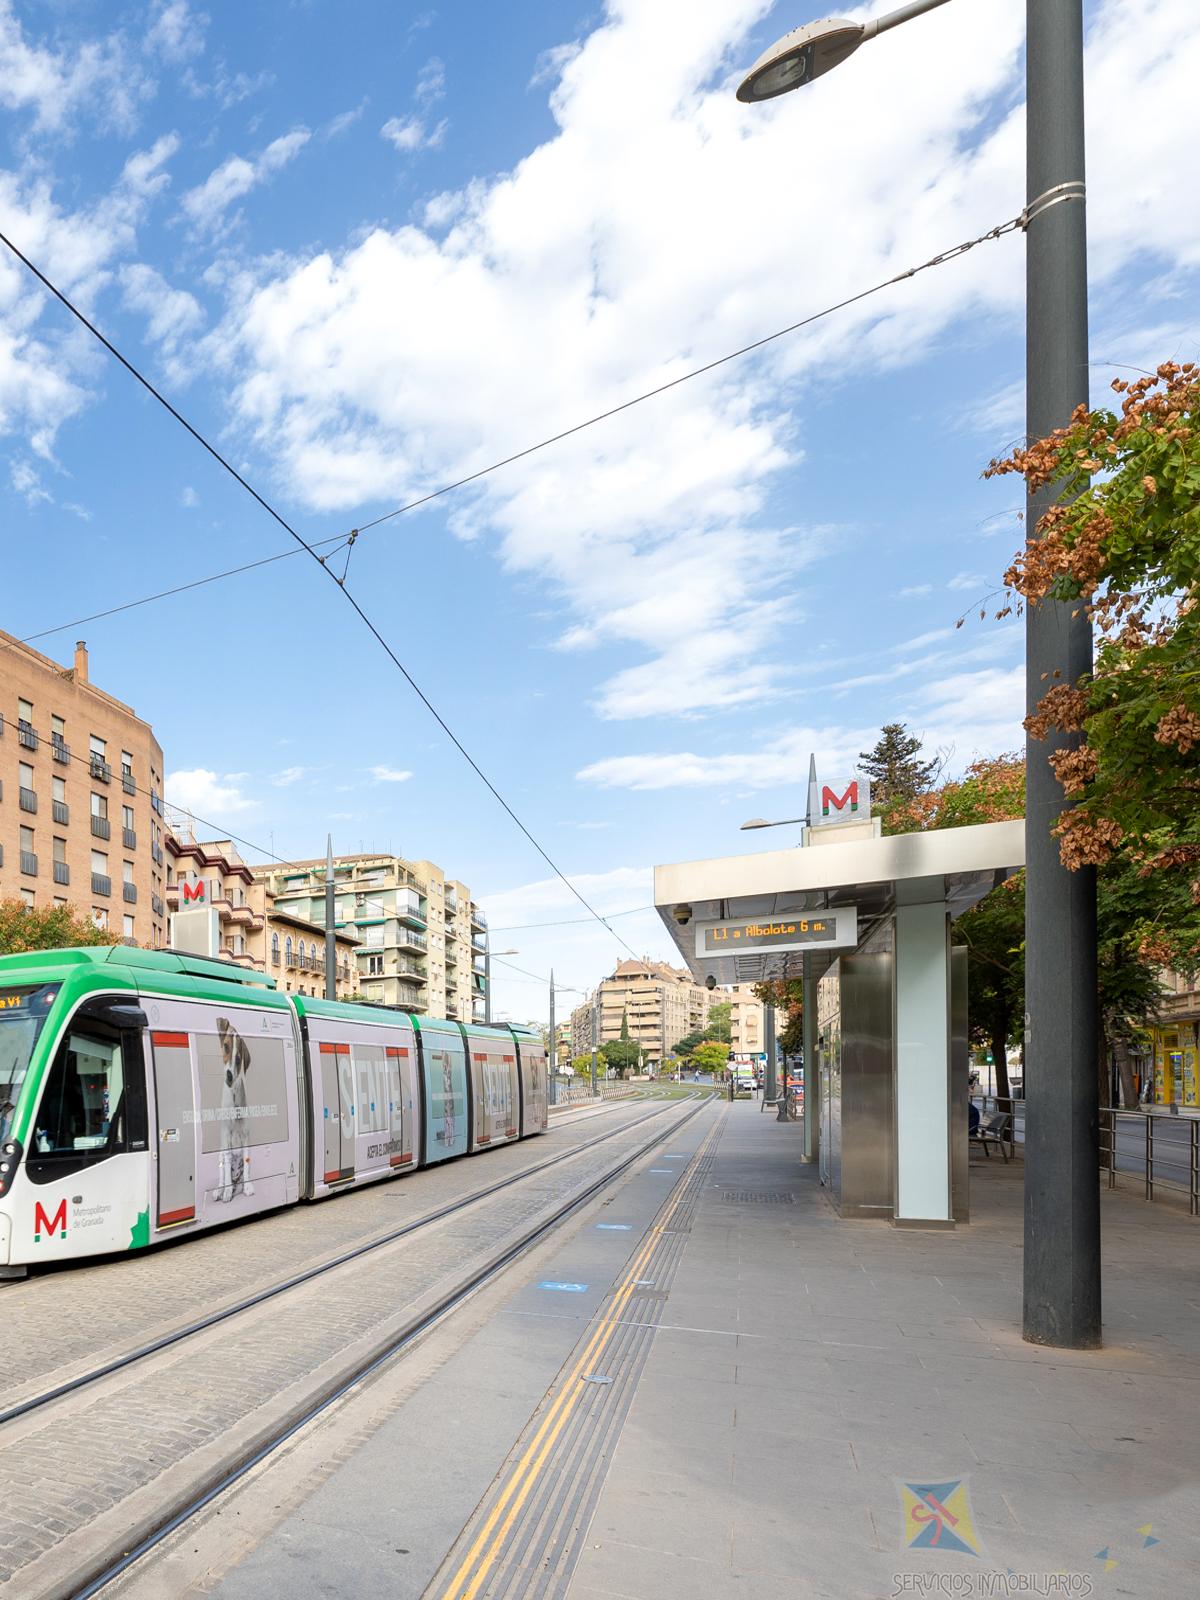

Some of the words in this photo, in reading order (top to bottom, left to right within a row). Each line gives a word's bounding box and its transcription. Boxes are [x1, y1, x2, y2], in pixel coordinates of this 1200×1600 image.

[822, 781, 858, 816] M
[184, 880, 205, 905] M
[745, 923, 796, 937] Albolote
[801, 920, 809, 932] 6
[34, 1198, 67, 1243] M
